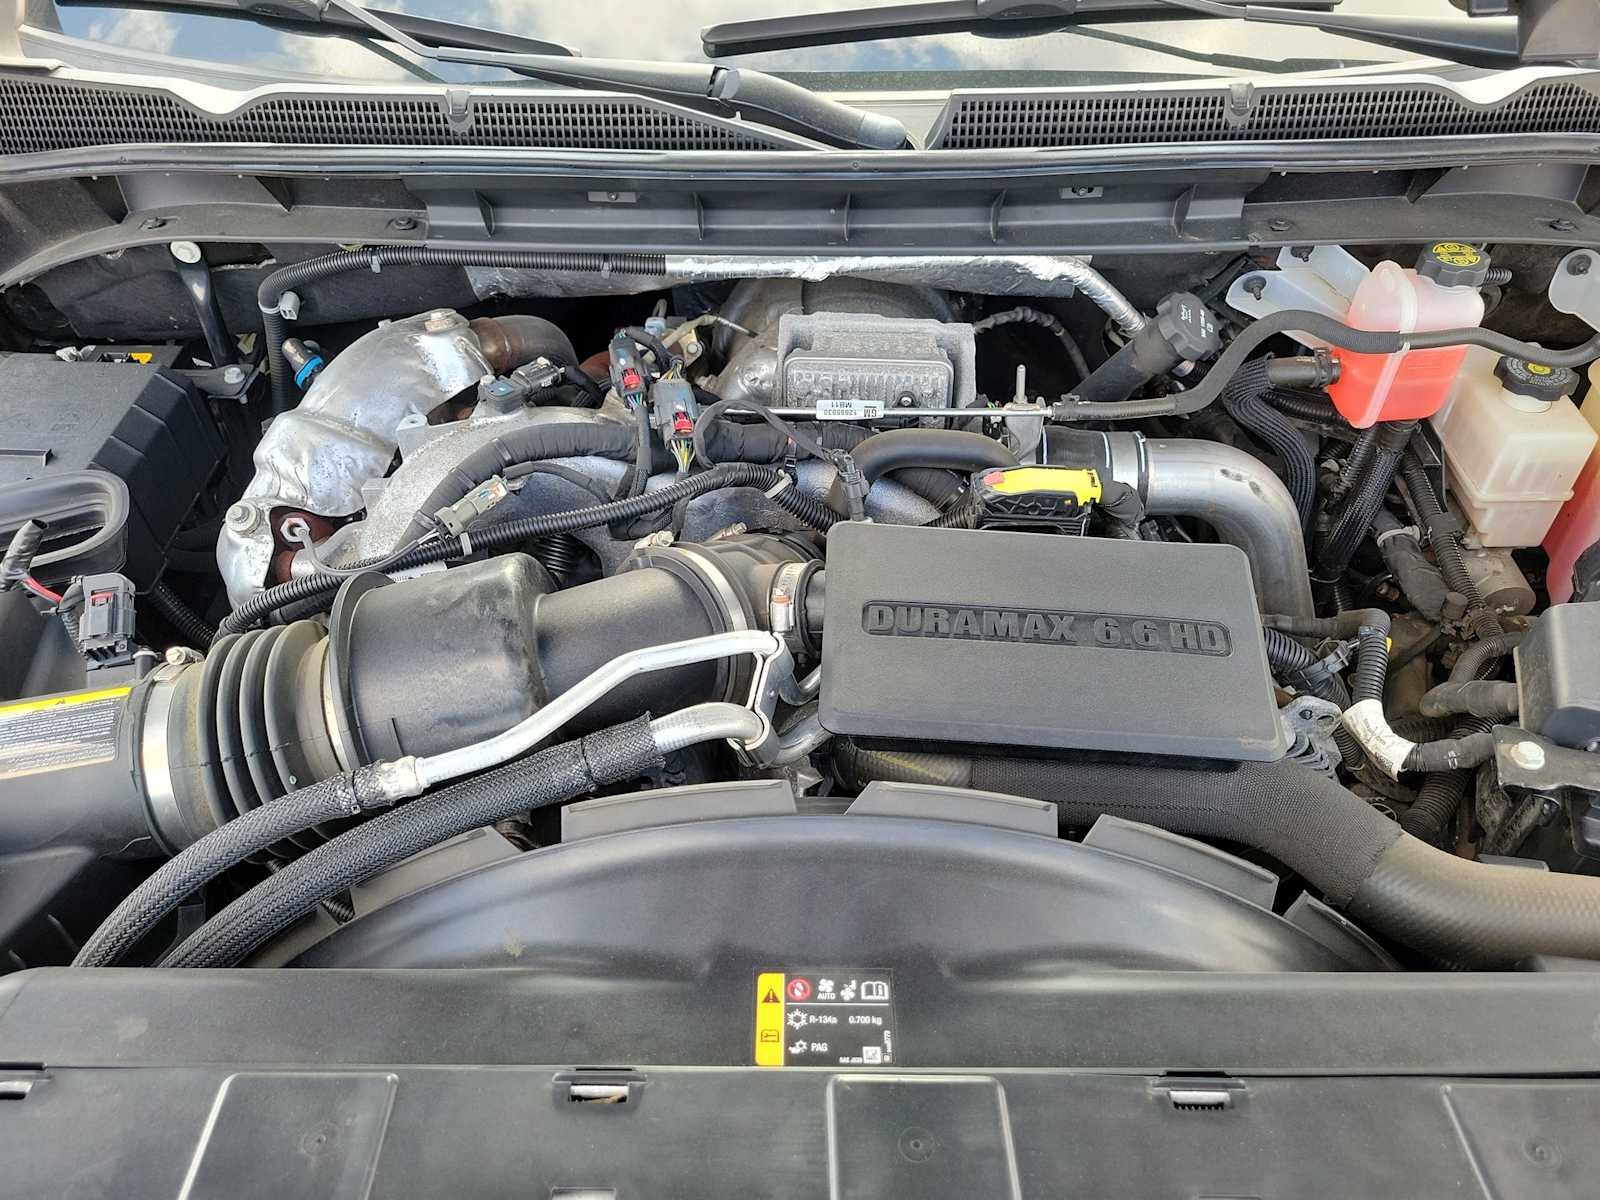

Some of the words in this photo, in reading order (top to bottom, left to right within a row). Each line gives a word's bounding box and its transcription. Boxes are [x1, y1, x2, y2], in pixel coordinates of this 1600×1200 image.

[863, 406, 877, 417] GM
[868, 605, 1076, 642] DURAMAX
[1094, 617, 1160, 649] 6.6
[1169, 622, 1229, 652] HD
[817, 992, 836, 1000] AUTO
[809, 1016, 838, 1025] R-134a
[848, 1015, 871, 1025] 0.700
[871, 1016, 882, 1026] kg
[811, 1042, 828, 1052] PAG
